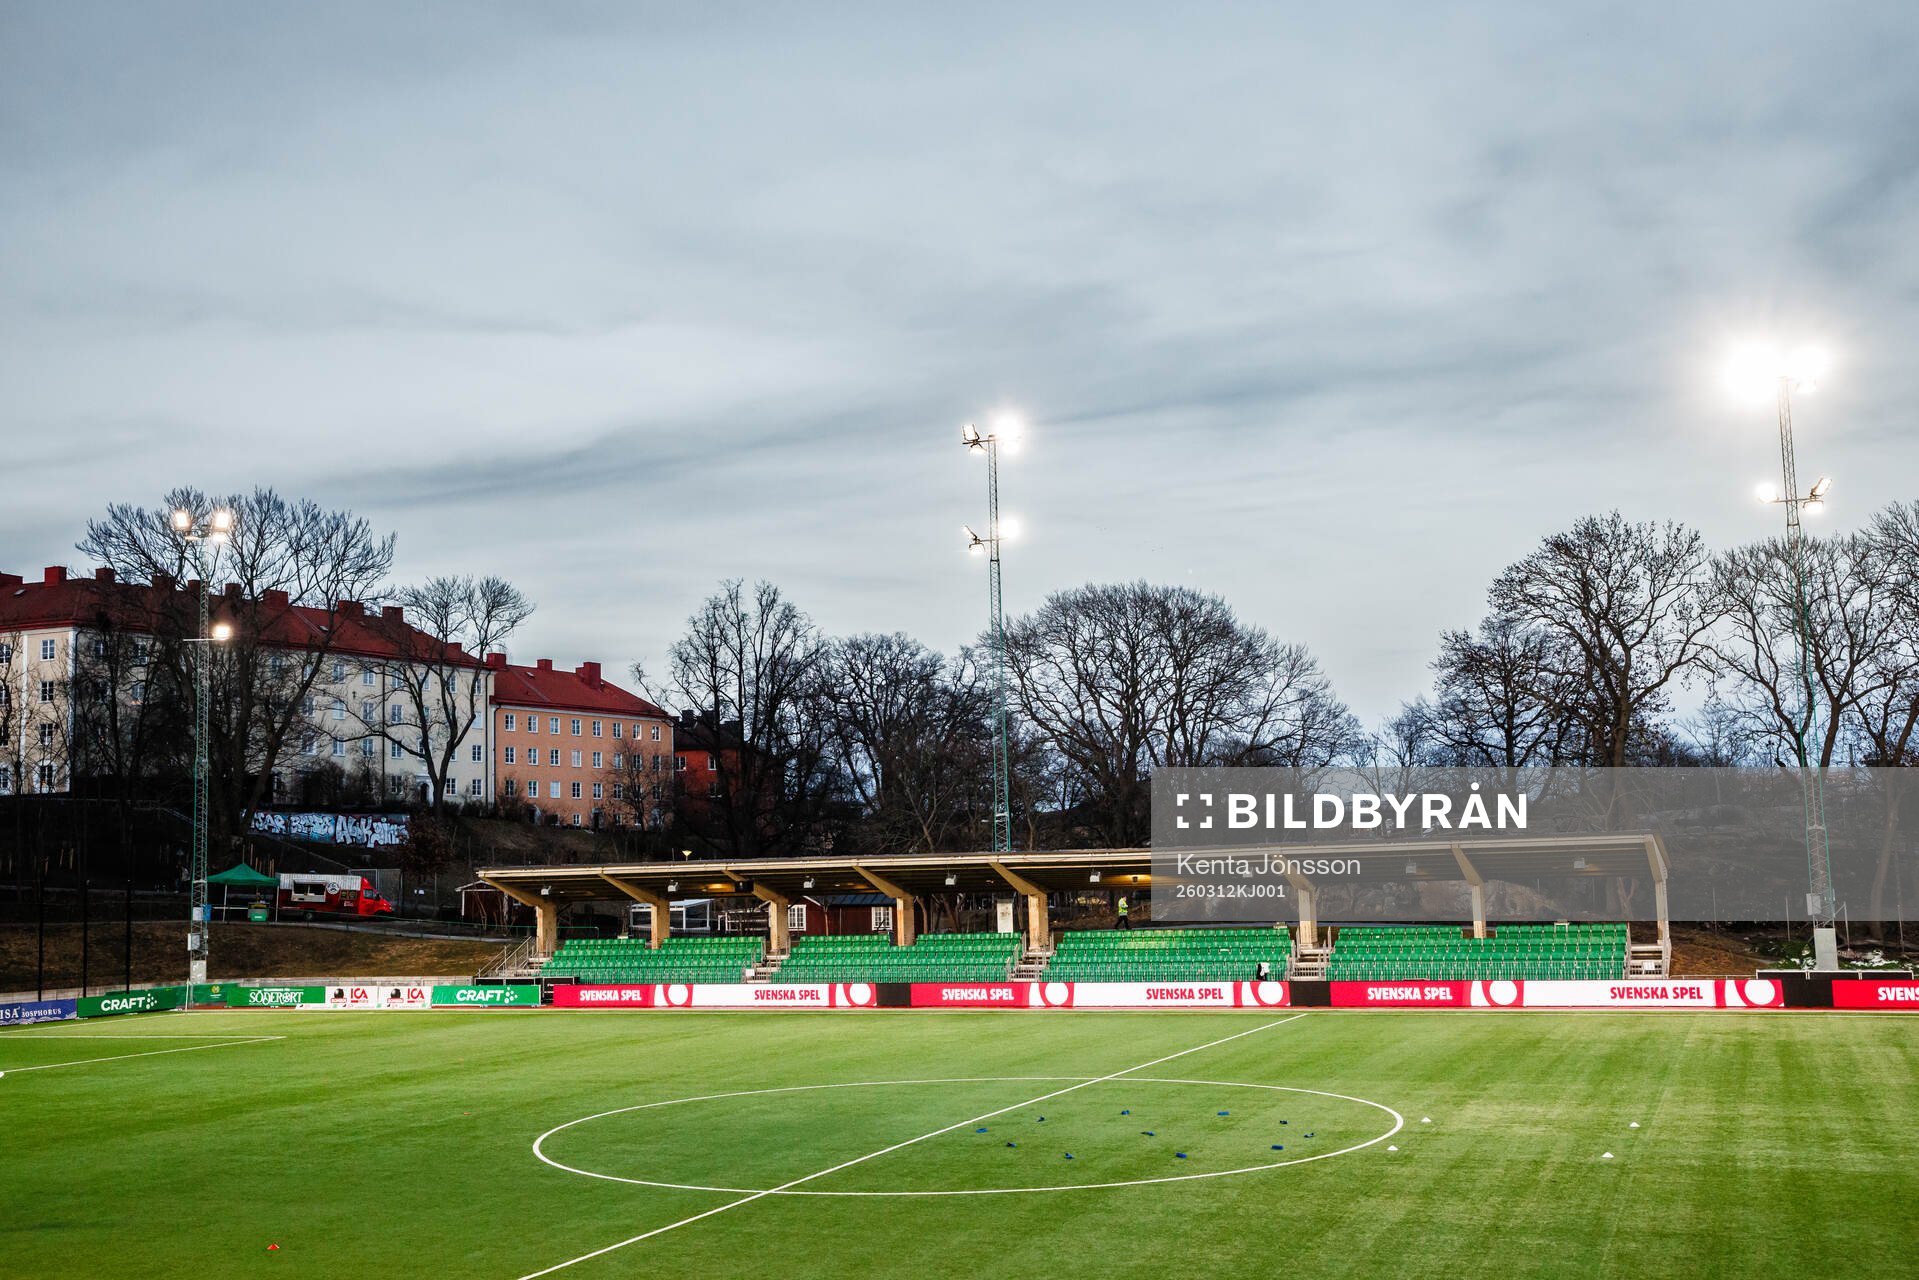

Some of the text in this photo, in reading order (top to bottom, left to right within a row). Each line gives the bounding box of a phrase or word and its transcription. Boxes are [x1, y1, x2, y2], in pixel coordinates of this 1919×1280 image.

[350, 987, 369, 1000] ICA
[407, 987, 425, 1000] ICA
[455, 989, 504, 1002] CRAFT
[579, 989, 642, 1001] SVENSKA SPEL
[754, 989, 821, 1001] SVENSKA SPEL
[941, 988, 1015, 1001] SVENSKA SPEL
[1146, 987, 1224, 1000] SVENSKA SPEL
[1367, 986, 1453, 1001] SVENSKA SPEL
[1610, 986, 1704, 1000] SVENSKA SPEL
[100, 997, 146, 1012] CRAFT
